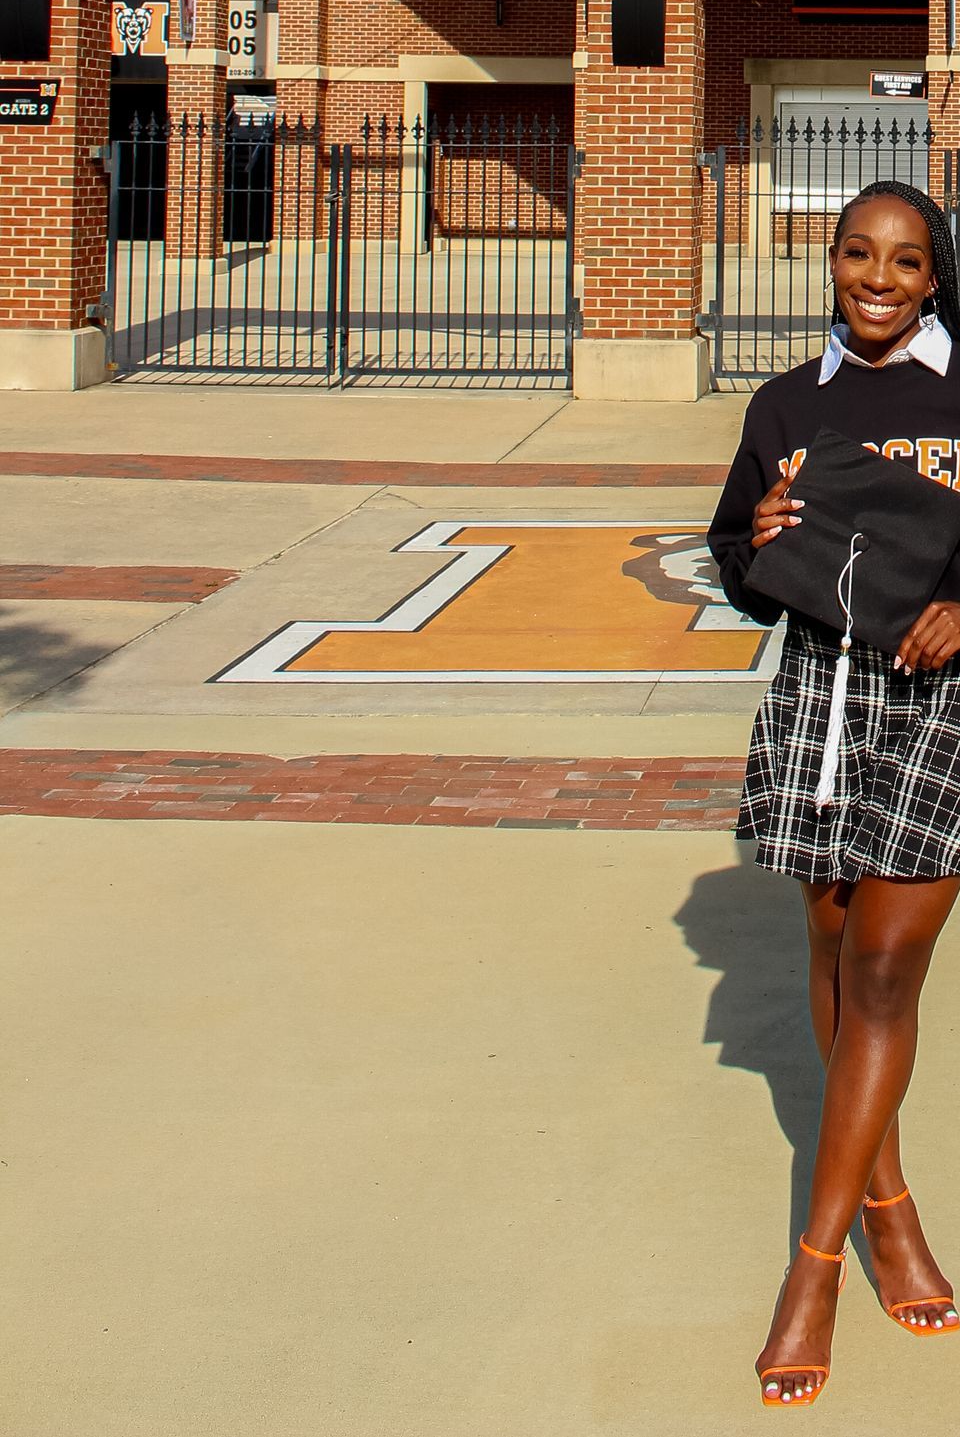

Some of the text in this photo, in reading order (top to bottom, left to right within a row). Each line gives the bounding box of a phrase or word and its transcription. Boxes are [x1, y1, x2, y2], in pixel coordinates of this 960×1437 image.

[874, 74, 923, 84] GUEST SERVICES
[0, 104, 49, 115] GATE 2
